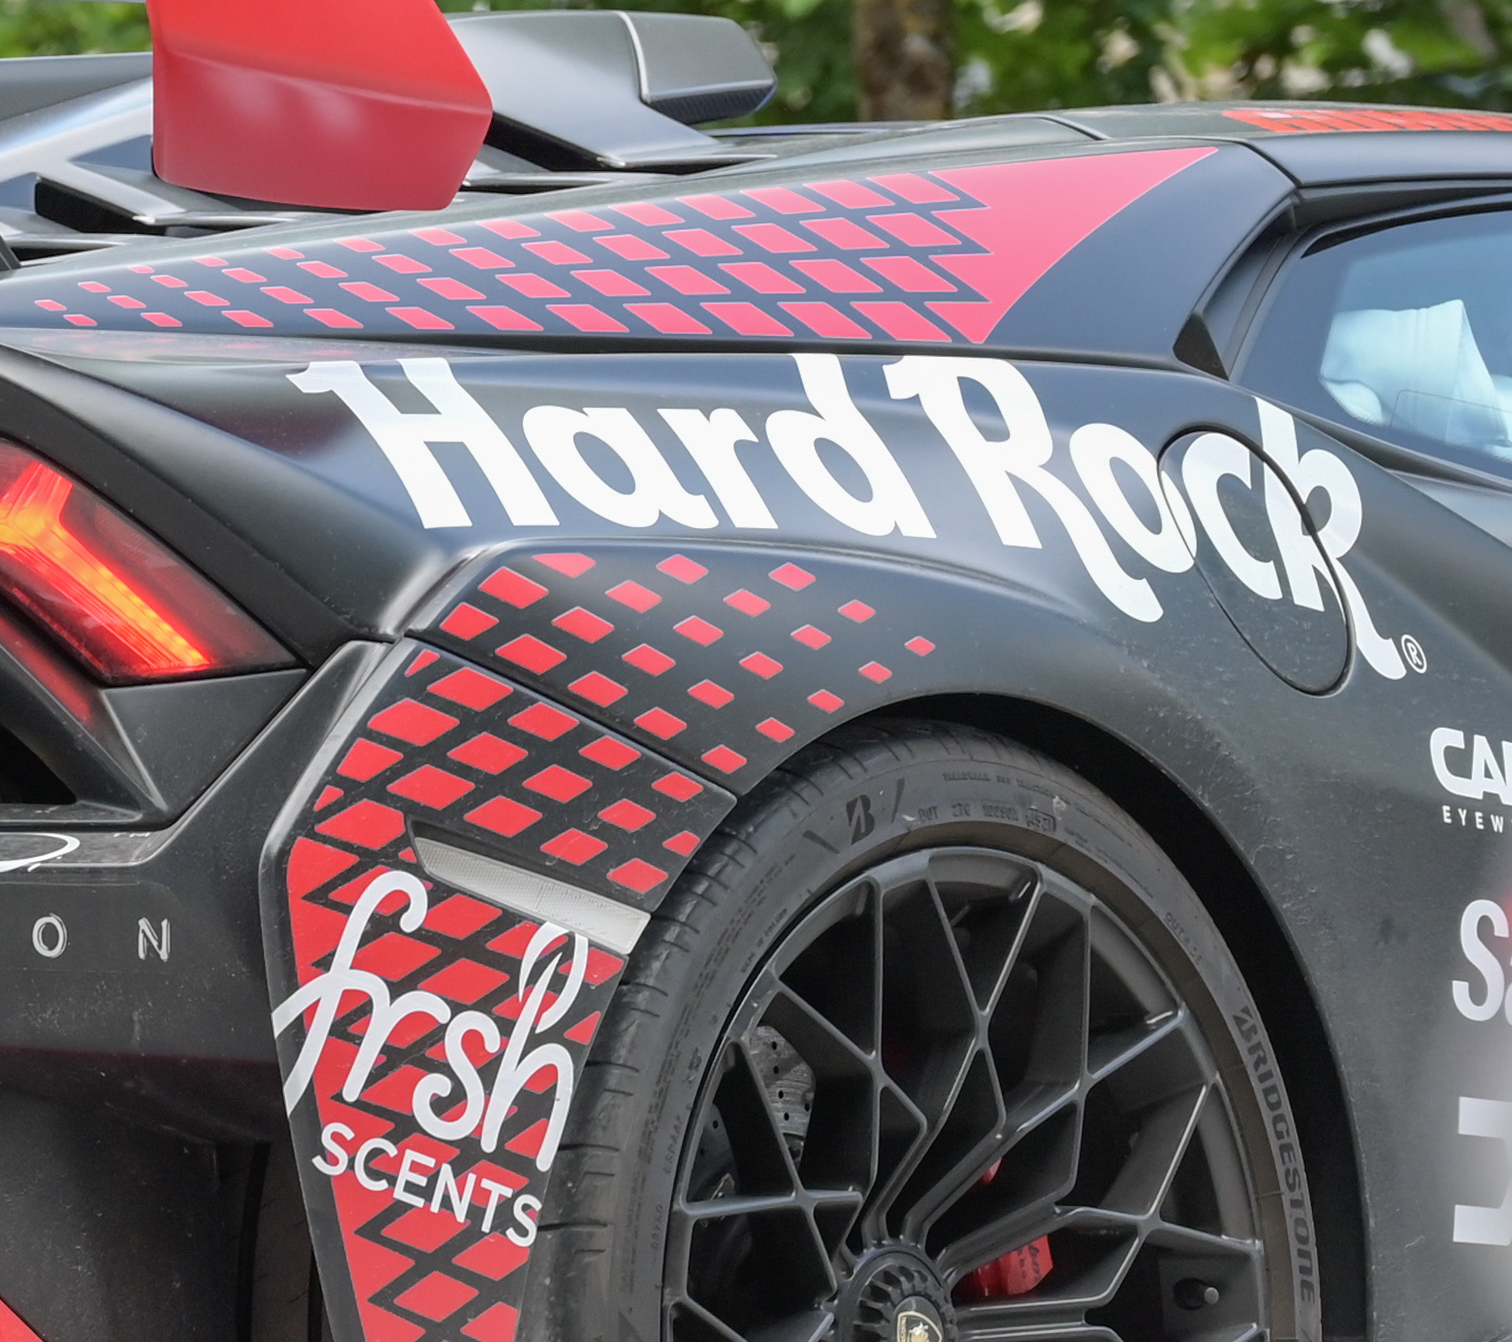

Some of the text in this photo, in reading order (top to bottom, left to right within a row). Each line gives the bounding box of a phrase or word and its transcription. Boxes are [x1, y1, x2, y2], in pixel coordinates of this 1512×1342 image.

[290, 353, 1410, 681] Hard Rock
[271, 869, 589, 1173] frsh
[311, 1121, 543, 1248] SCENTS
